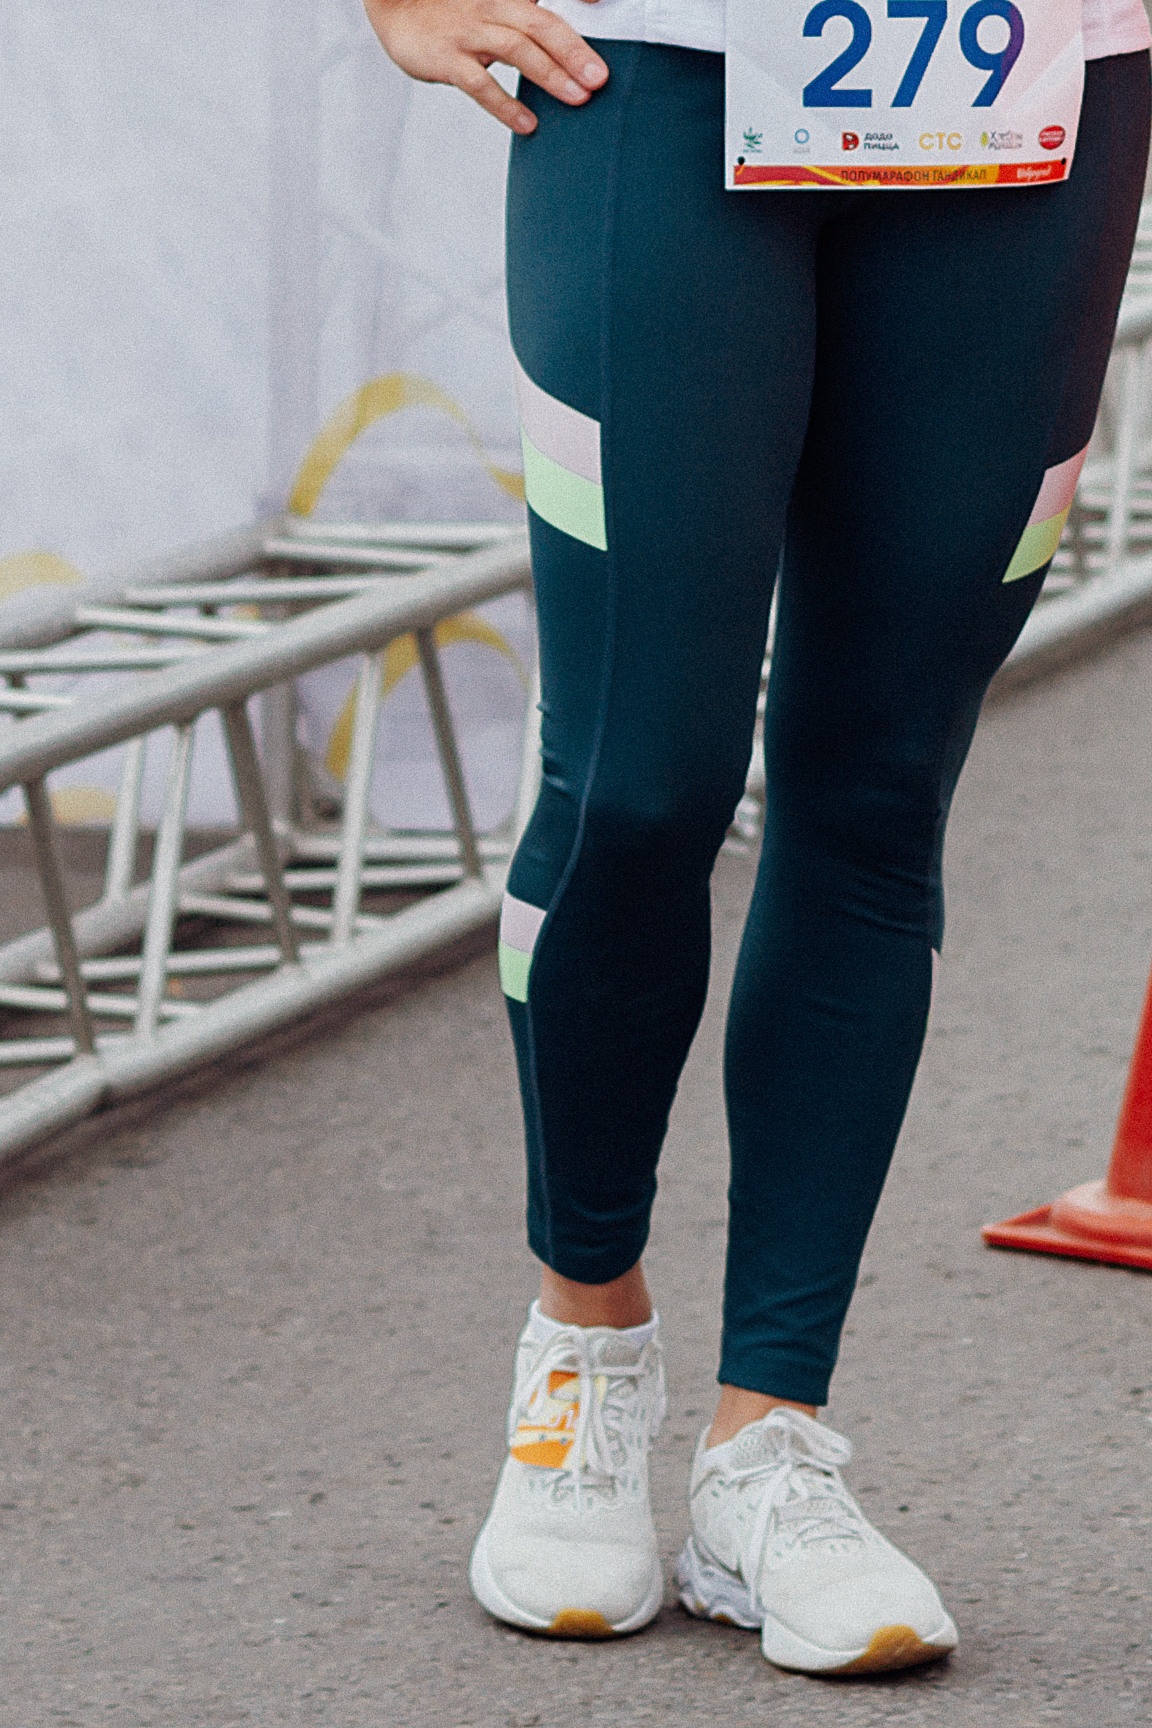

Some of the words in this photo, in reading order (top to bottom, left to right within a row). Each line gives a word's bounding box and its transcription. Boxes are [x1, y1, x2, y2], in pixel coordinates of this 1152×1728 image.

[864, 132, 893, 141] ДОДО
[919, 132, 963, 150] СТС
[863, 142, 899, 151] ПИЦЦА
[841, 170, 930, 182] ПОЛУМАРАФОН
[932, 169, 987, 182] ГАНДИКАП
